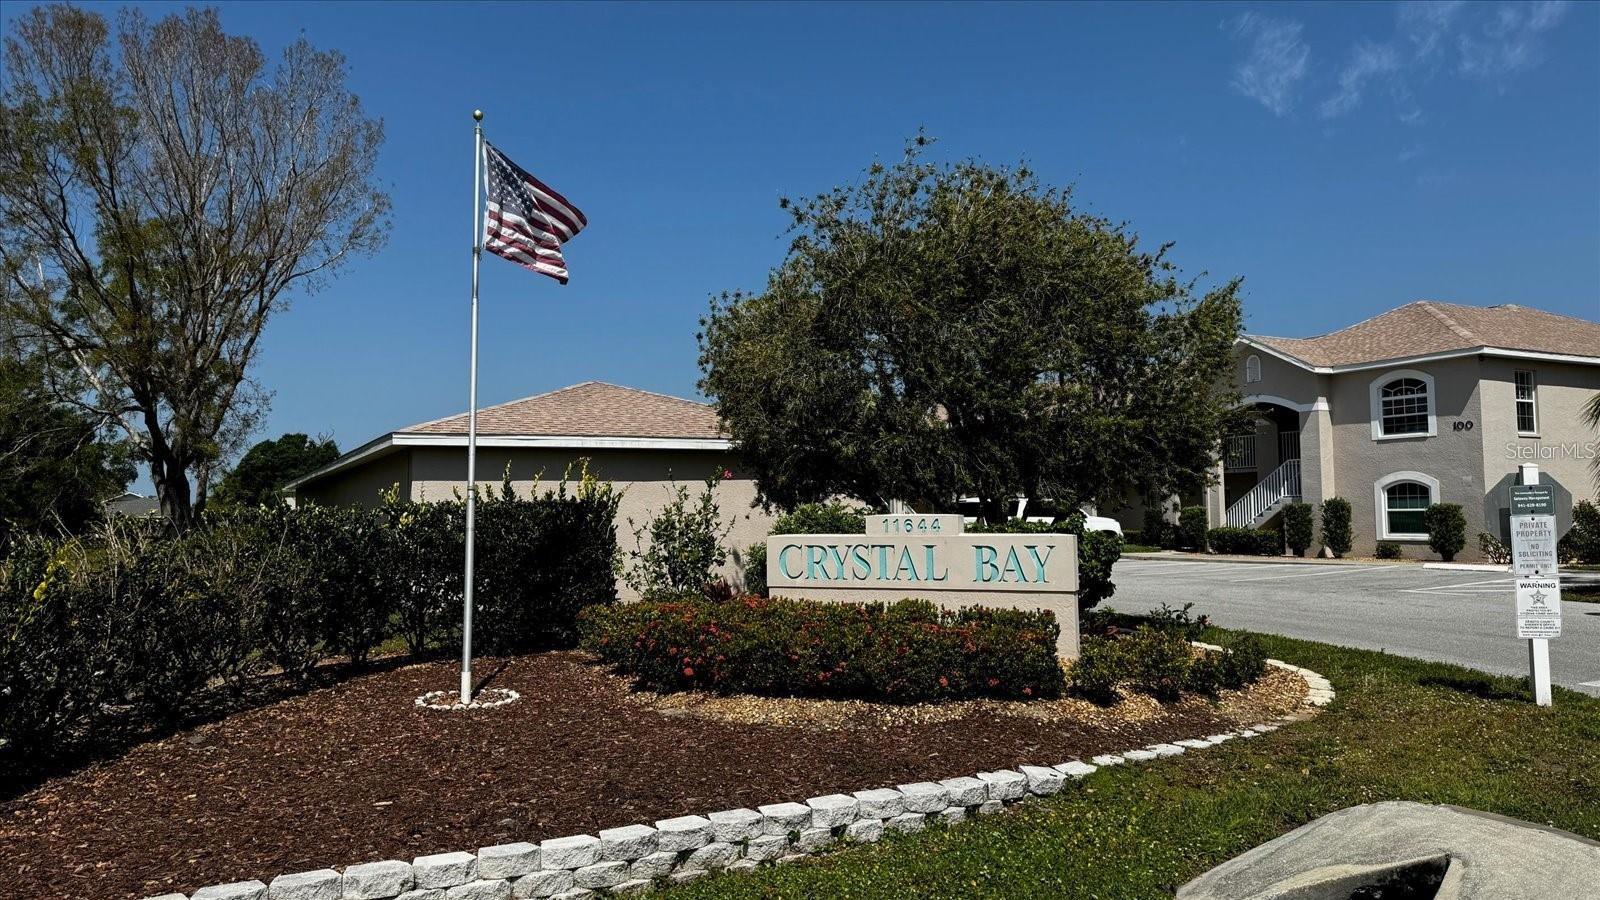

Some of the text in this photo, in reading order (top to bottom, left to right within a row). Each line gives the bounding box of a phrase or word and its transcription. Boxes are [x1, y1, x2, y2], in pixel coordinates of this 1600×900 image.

[1452, 420, 1474, 432] 100
[882, 518, 941, 533] 11644
[1519, 521, 1548, 529] PRIVATE
[1518, 550, 1553, 558] SOLICITING
[778, 543, 1056, 583] CRYSTAL BAY
